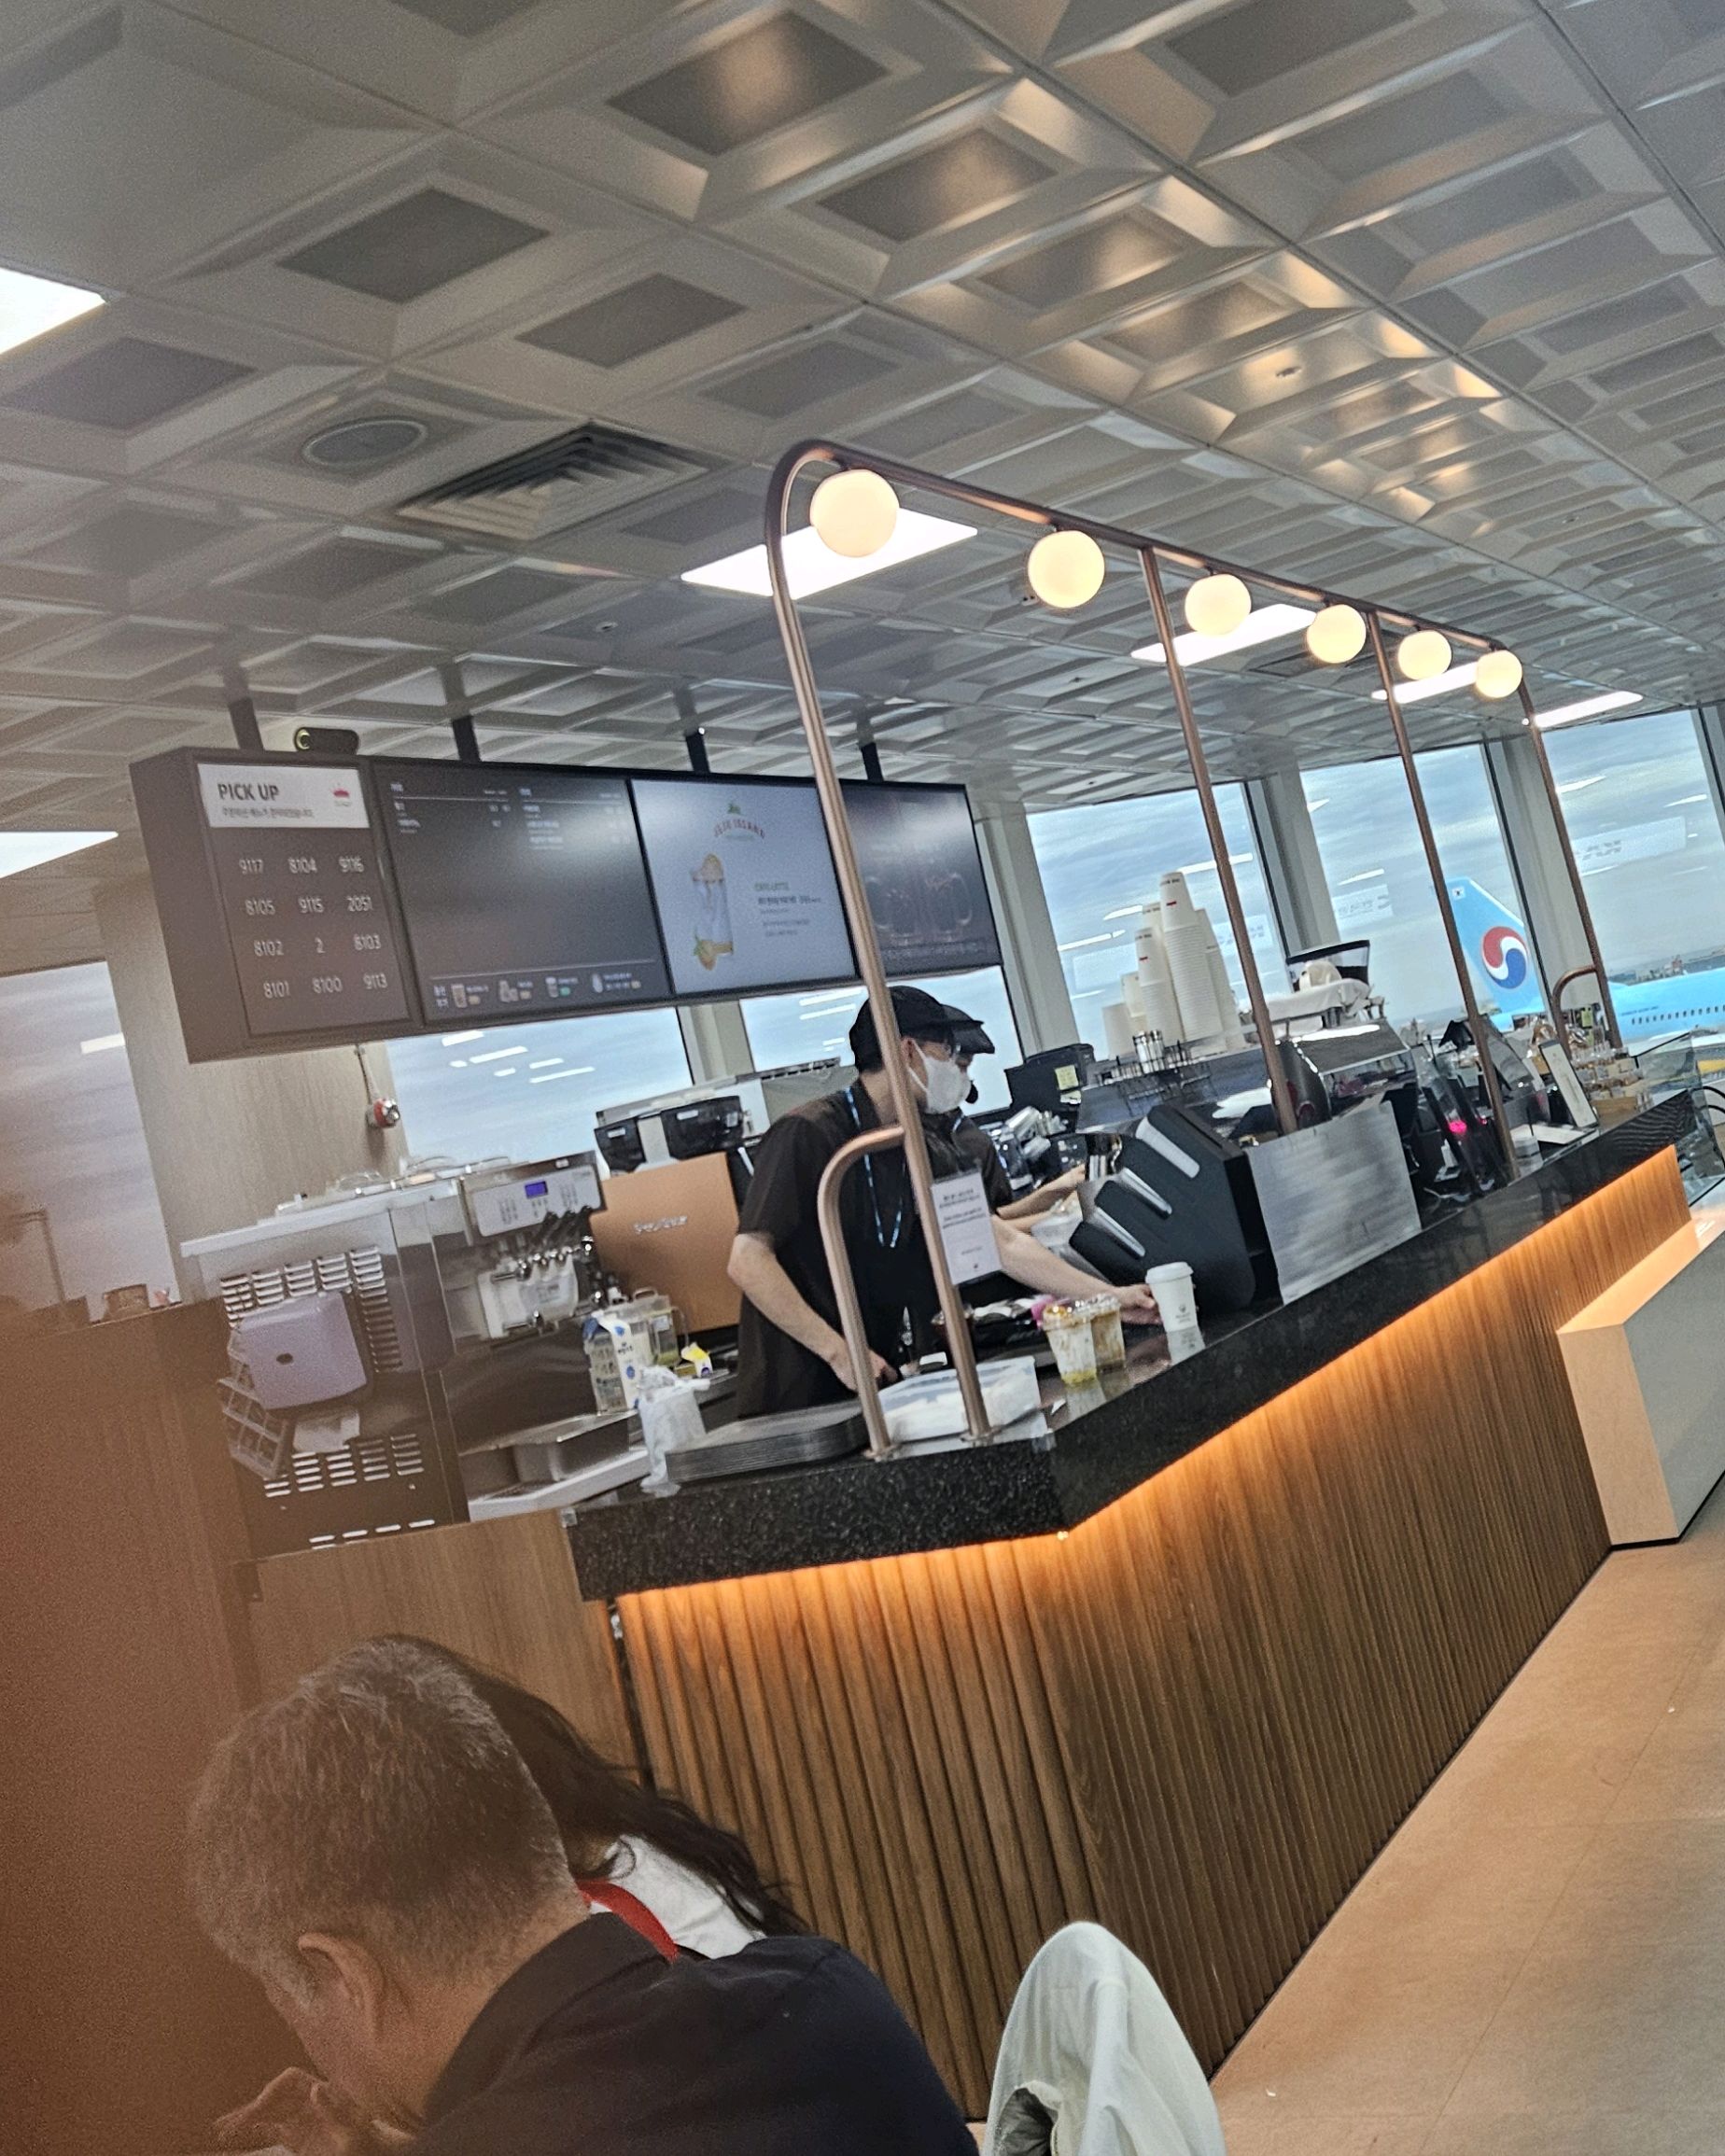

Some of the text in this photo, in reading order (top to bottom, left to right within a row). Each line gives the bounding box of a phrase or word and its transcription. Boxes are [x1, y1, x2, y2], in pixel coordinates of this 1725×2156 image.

[217, 783, 279, 801] PICK UP
[239, 859, 263, 875] 9117
[288, 856, 317, 874] 8104
[245, 898, 276, 916] 8105
[298, 896, 324, 914] 9115
[254, 939, 284, 957] 8102
[315, 937, 325, 954] 2
[263, 981, 290, 999] 8101
[313, 977, 343, 994] 8100
